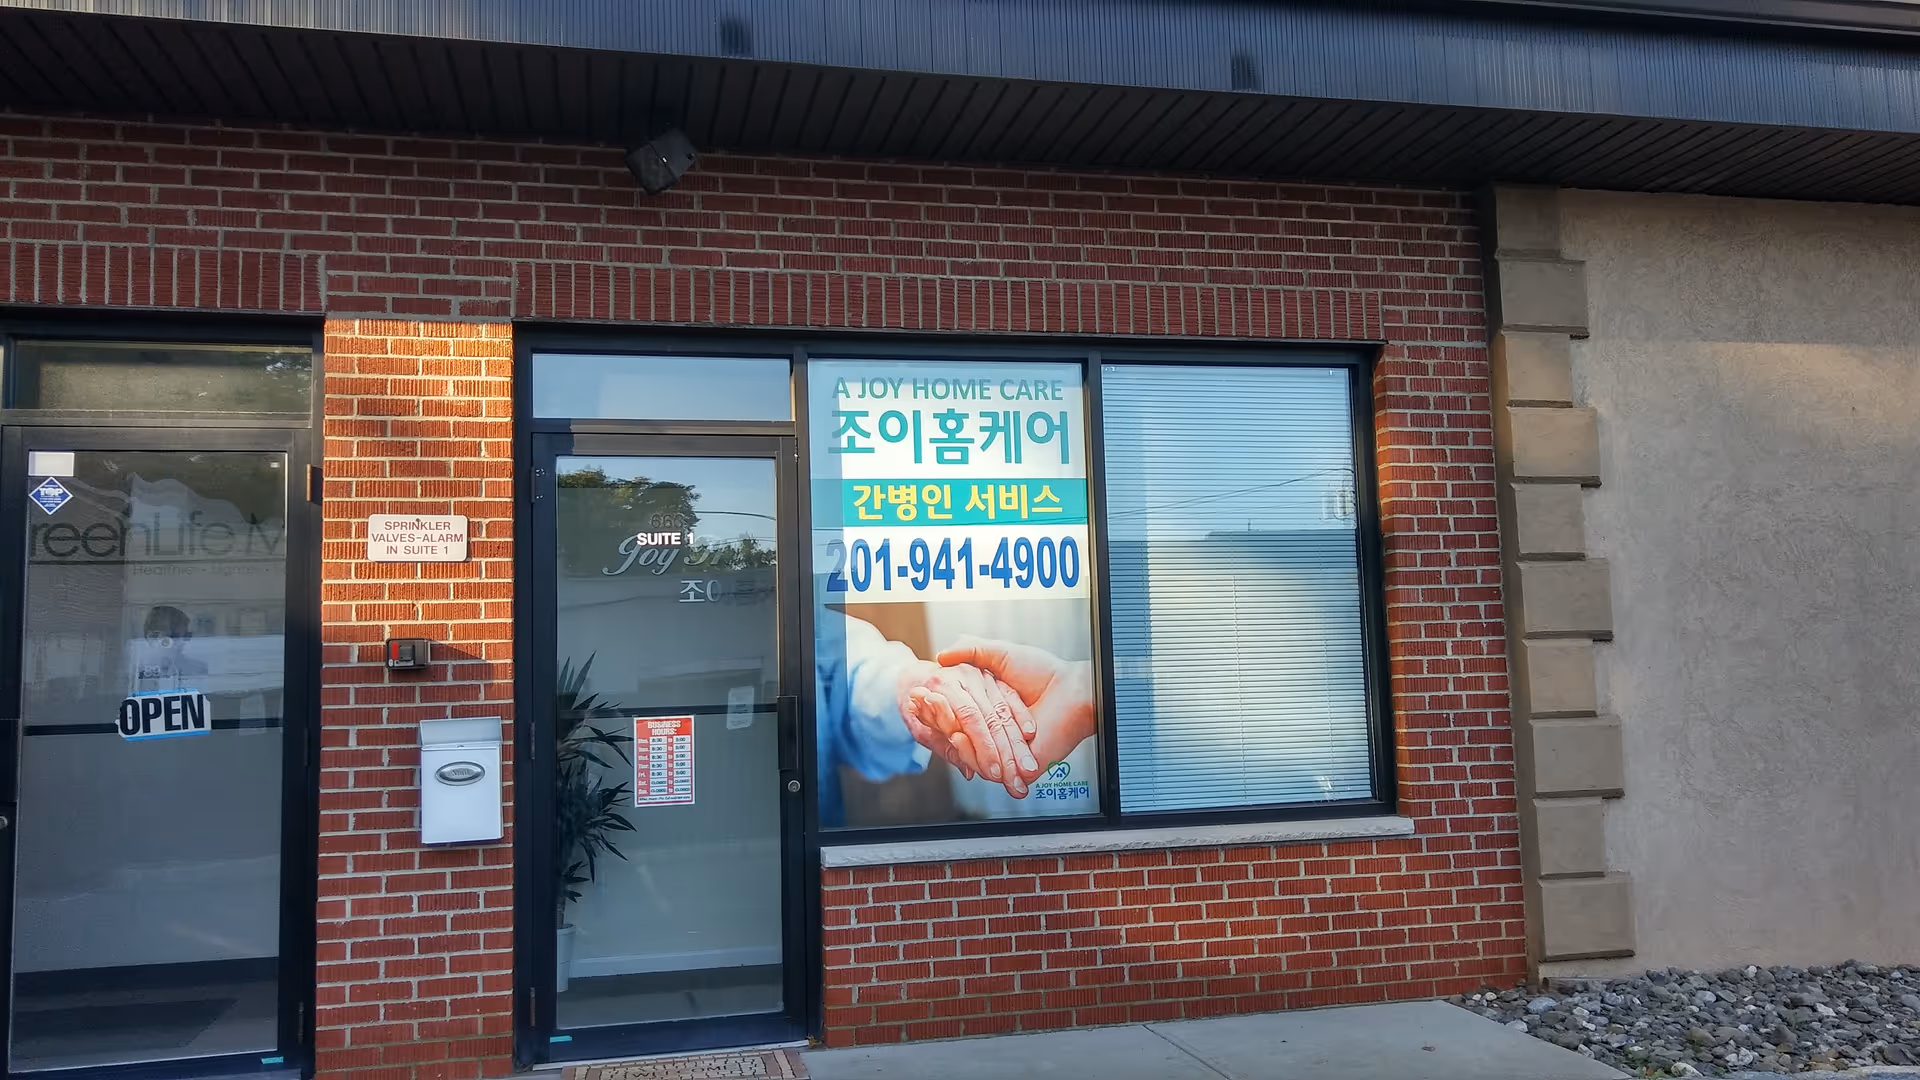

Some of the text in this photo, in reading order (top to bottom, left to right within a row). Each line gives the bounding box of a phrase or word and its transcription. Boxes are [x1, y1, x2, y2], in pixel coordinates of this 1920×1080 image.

[832, 377, 1063, 401] A JOY HOME CARE
[828, 408, 1069, 465] 조이홈케어
[853, 484, 1062, 521] 간병인 서비스
[372, 533, 464, 543] VALVES-ALARM
[384, 521, 451, 531] SPRINKLER
[386, 545, 449, 555] IN SUITE 1
[637, 532, 694, 546] SUITE 1
[602, 533, 680, 576] Joy
[826, 536, 1079, 592] 201-941-4900
[118, 694, 206, 736] OPEN
[1036, 787, 1089, 800] 조이홈케어
